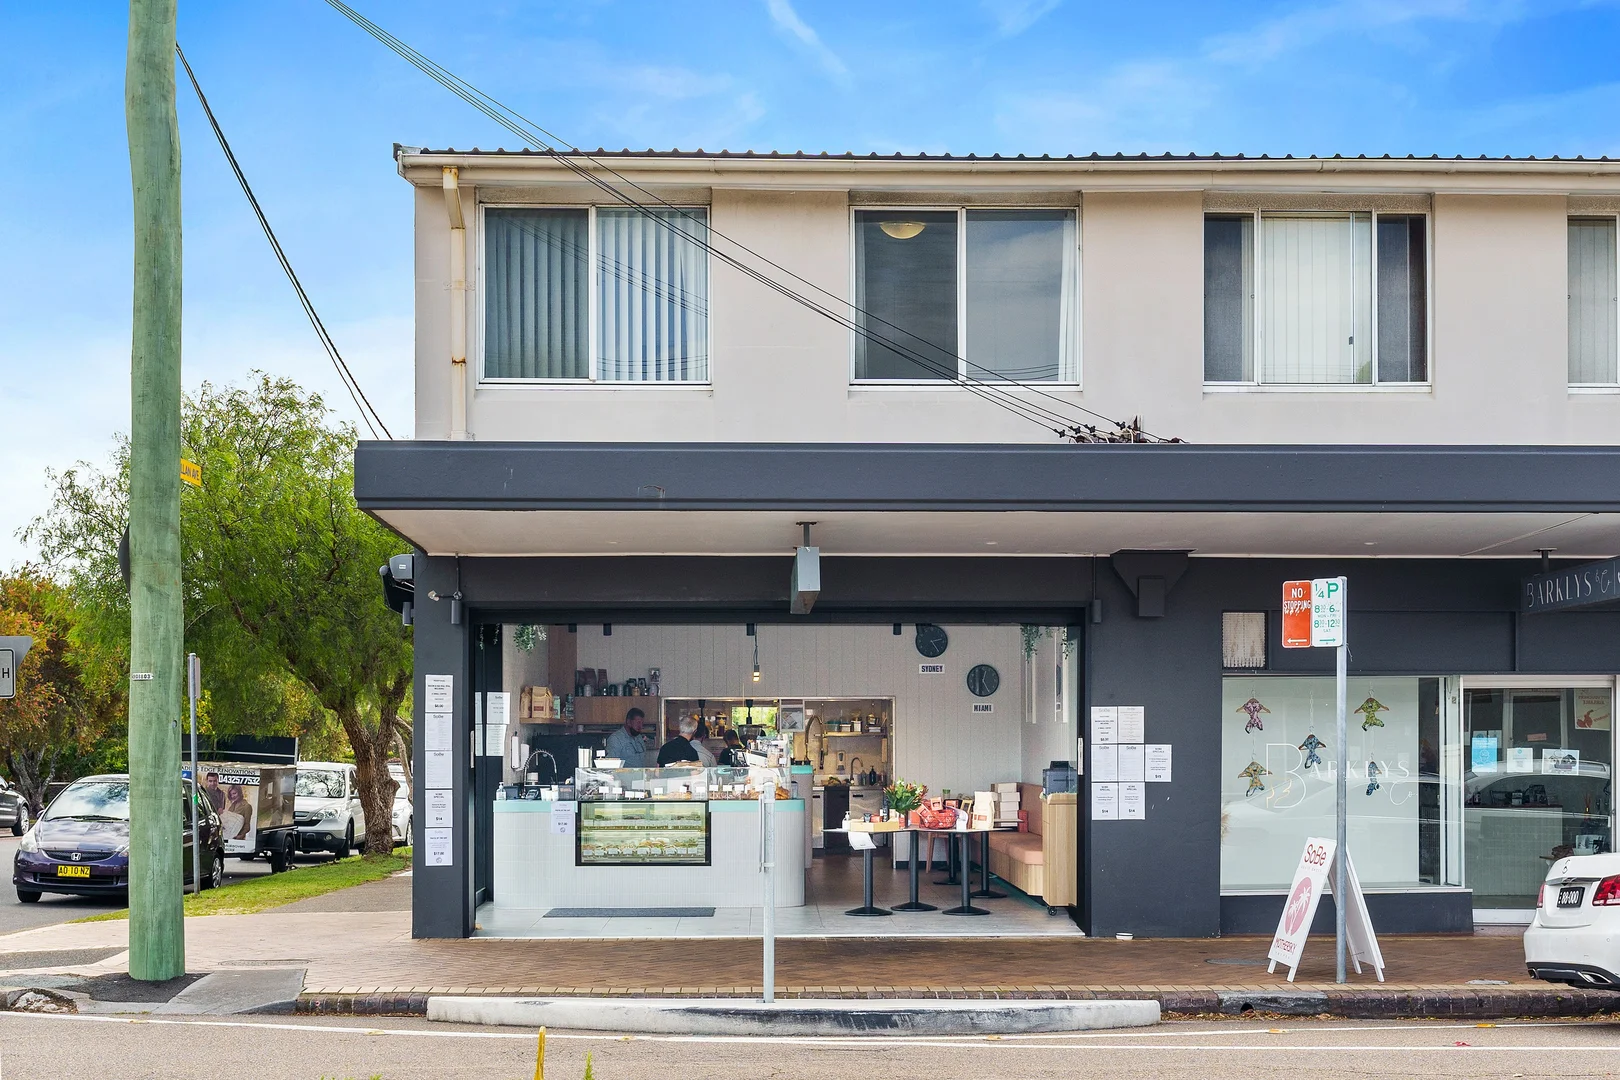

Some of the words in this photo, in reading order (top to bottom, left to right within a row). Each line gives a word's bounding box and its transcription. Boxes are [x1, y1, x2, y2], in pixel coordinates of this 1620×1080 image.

[1291, 587, 1303, 598] NO
[1327, 582, 1339, 599] P
[1526, 571, 1592, 608] BARKLYS
[1284, 599, 1311, 610] STOPPING
[921, 665, 943, 673] SYDNEY
[973, 704, 992, 712] MIAMI
[1266, 743, 1410, 808] BARKLYS
[1304, 843, 1327, 867] SoBe
